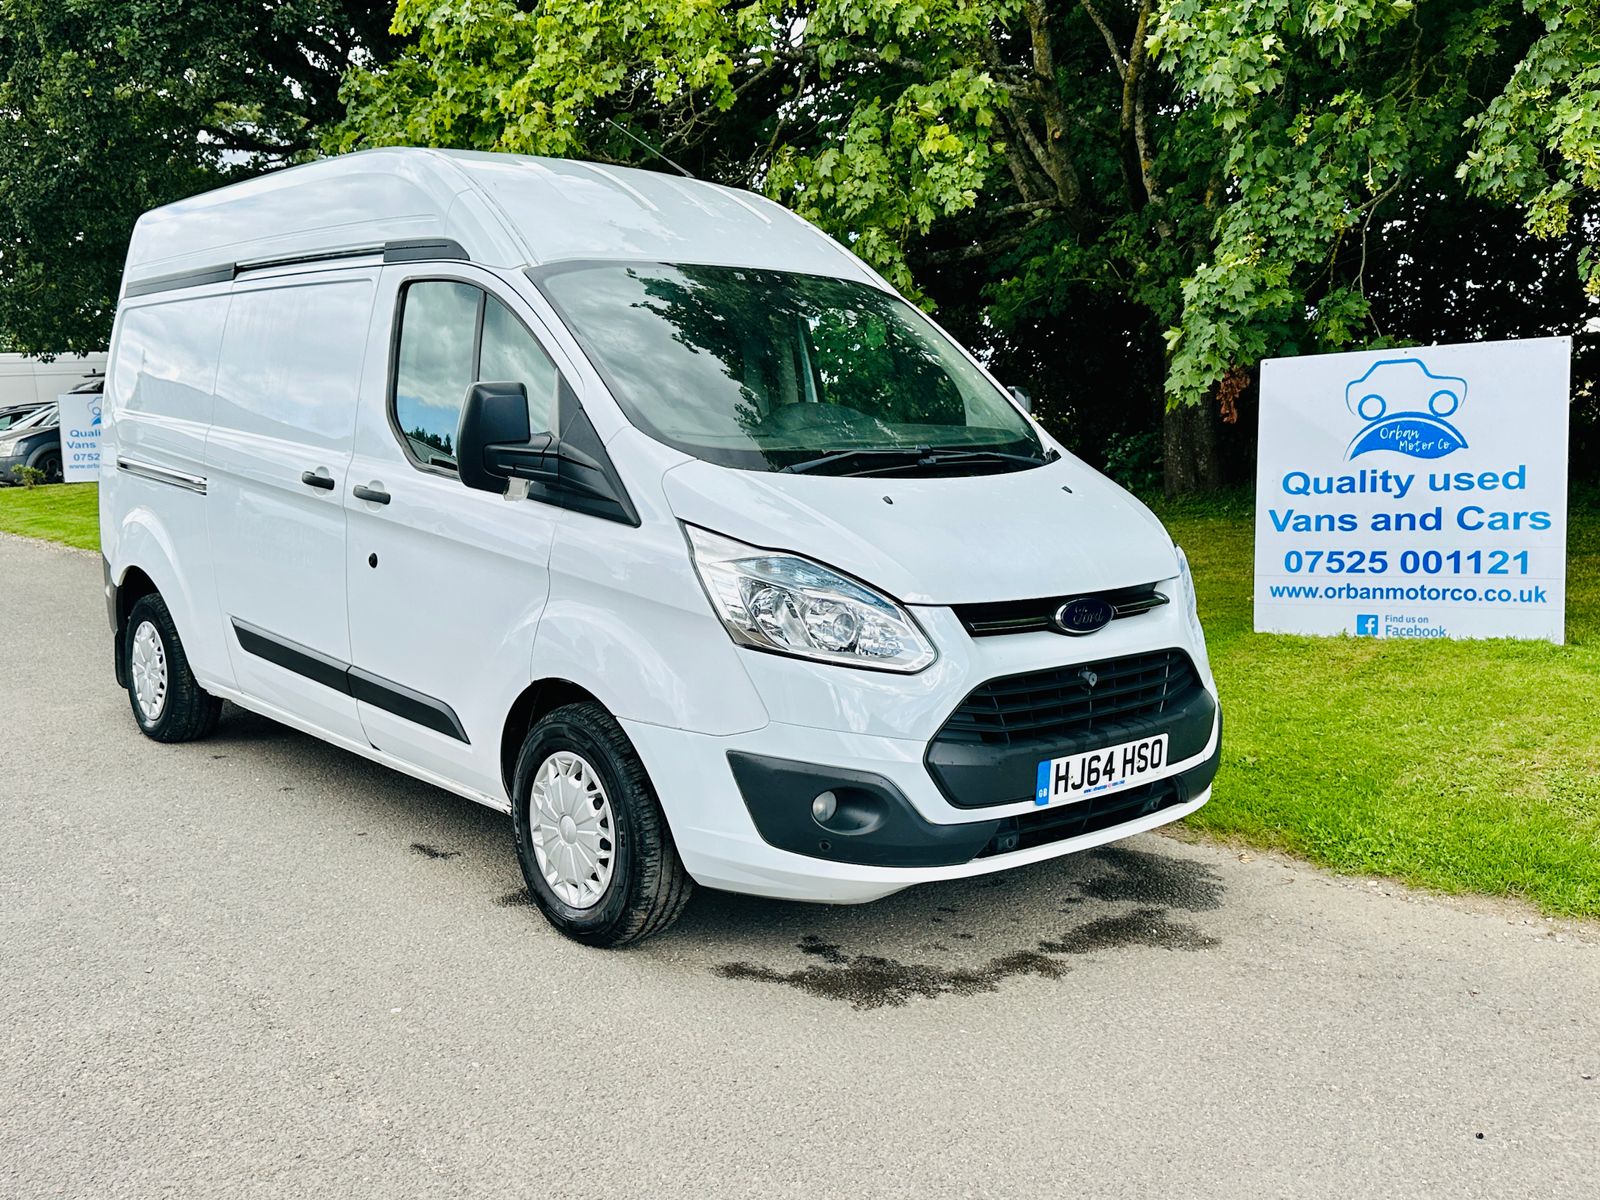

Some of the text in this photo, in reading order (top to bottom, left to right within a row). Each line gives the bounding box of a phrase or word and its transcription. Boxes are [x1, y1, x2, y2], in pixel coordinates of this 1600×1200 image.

[1380, 425, 1420, 440] Orban
[66, 441, 97, 449] Vans
[1399, 440, 1434, 452] Motor
[1282, 464, 1527, 499] Quality used
[1268, 505, 1552, 532] Vans and Cars
[1284, 550, 1529, 575] 07525 001121
[1270, 583, 1547, 603] www.orbanmotorco.co.uk
[1073, 606, 1104, 624] Ford
[1385, 614, 1404, 623] Find
[1406, 615, 1416, 623] us
[1385, 624, 1447, 637] Facebook
[1054, 738, 1163, 795] HJ64 HSO
[1038, 788, 1048, 798] GB
